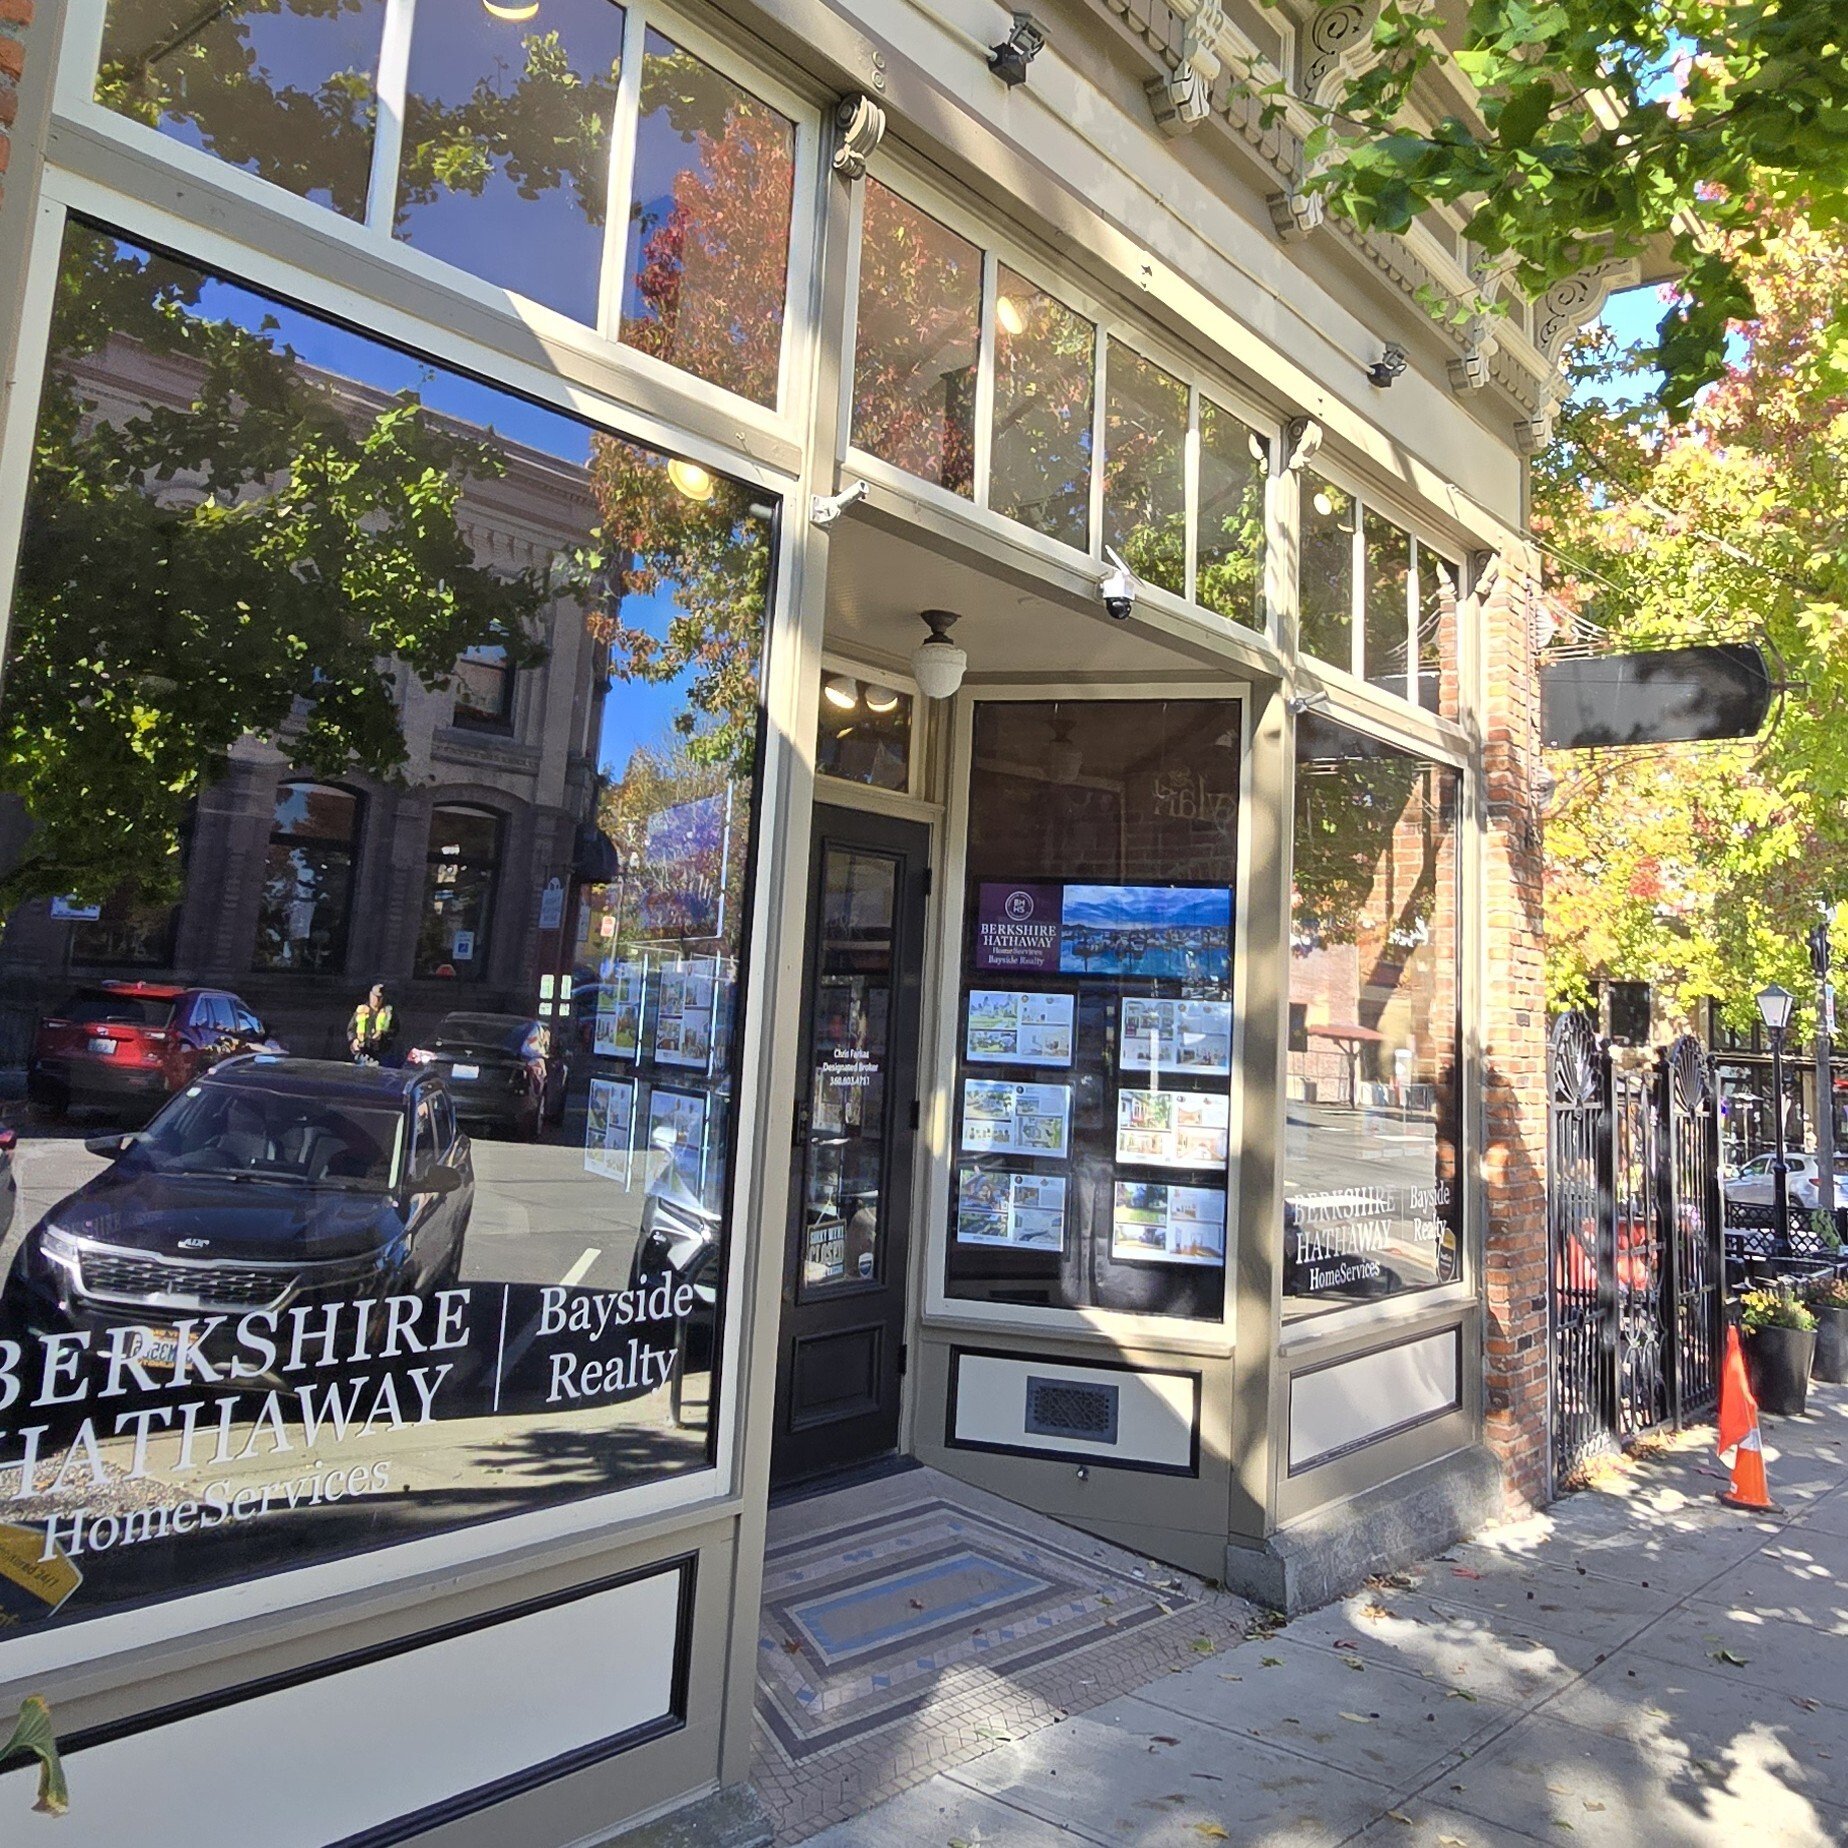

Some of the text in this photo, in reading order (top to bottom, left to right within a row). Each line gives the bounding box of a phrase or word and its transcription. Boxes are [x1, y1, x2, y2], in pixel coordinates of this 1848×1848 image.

[981, 923, 1057, 937] BERKSHIRE
[983, 935, 1054, 948] HATHAWAY
[988, 954, 1018, 966] Bayside
[823, 1062, 878, 1073] Designated Broker
[1293, 1185, 1396, 1226] BERKSHIRE
[1410, 1180, 1450, 1214] Bayside
[1295, 1219, 1392, 1264] HATHAWAY
[1414, 1212, 1447, 1243] Realty
[1310, 1259, 1380, 1290] HomeServices
[536, 1271, 694, 1342] Bayside
[546, 1338, 678, 1402] Realty
[0, 1364, 453, 1501] HATHAWAY
[38, 1460, 392, 1563] HomeServices
